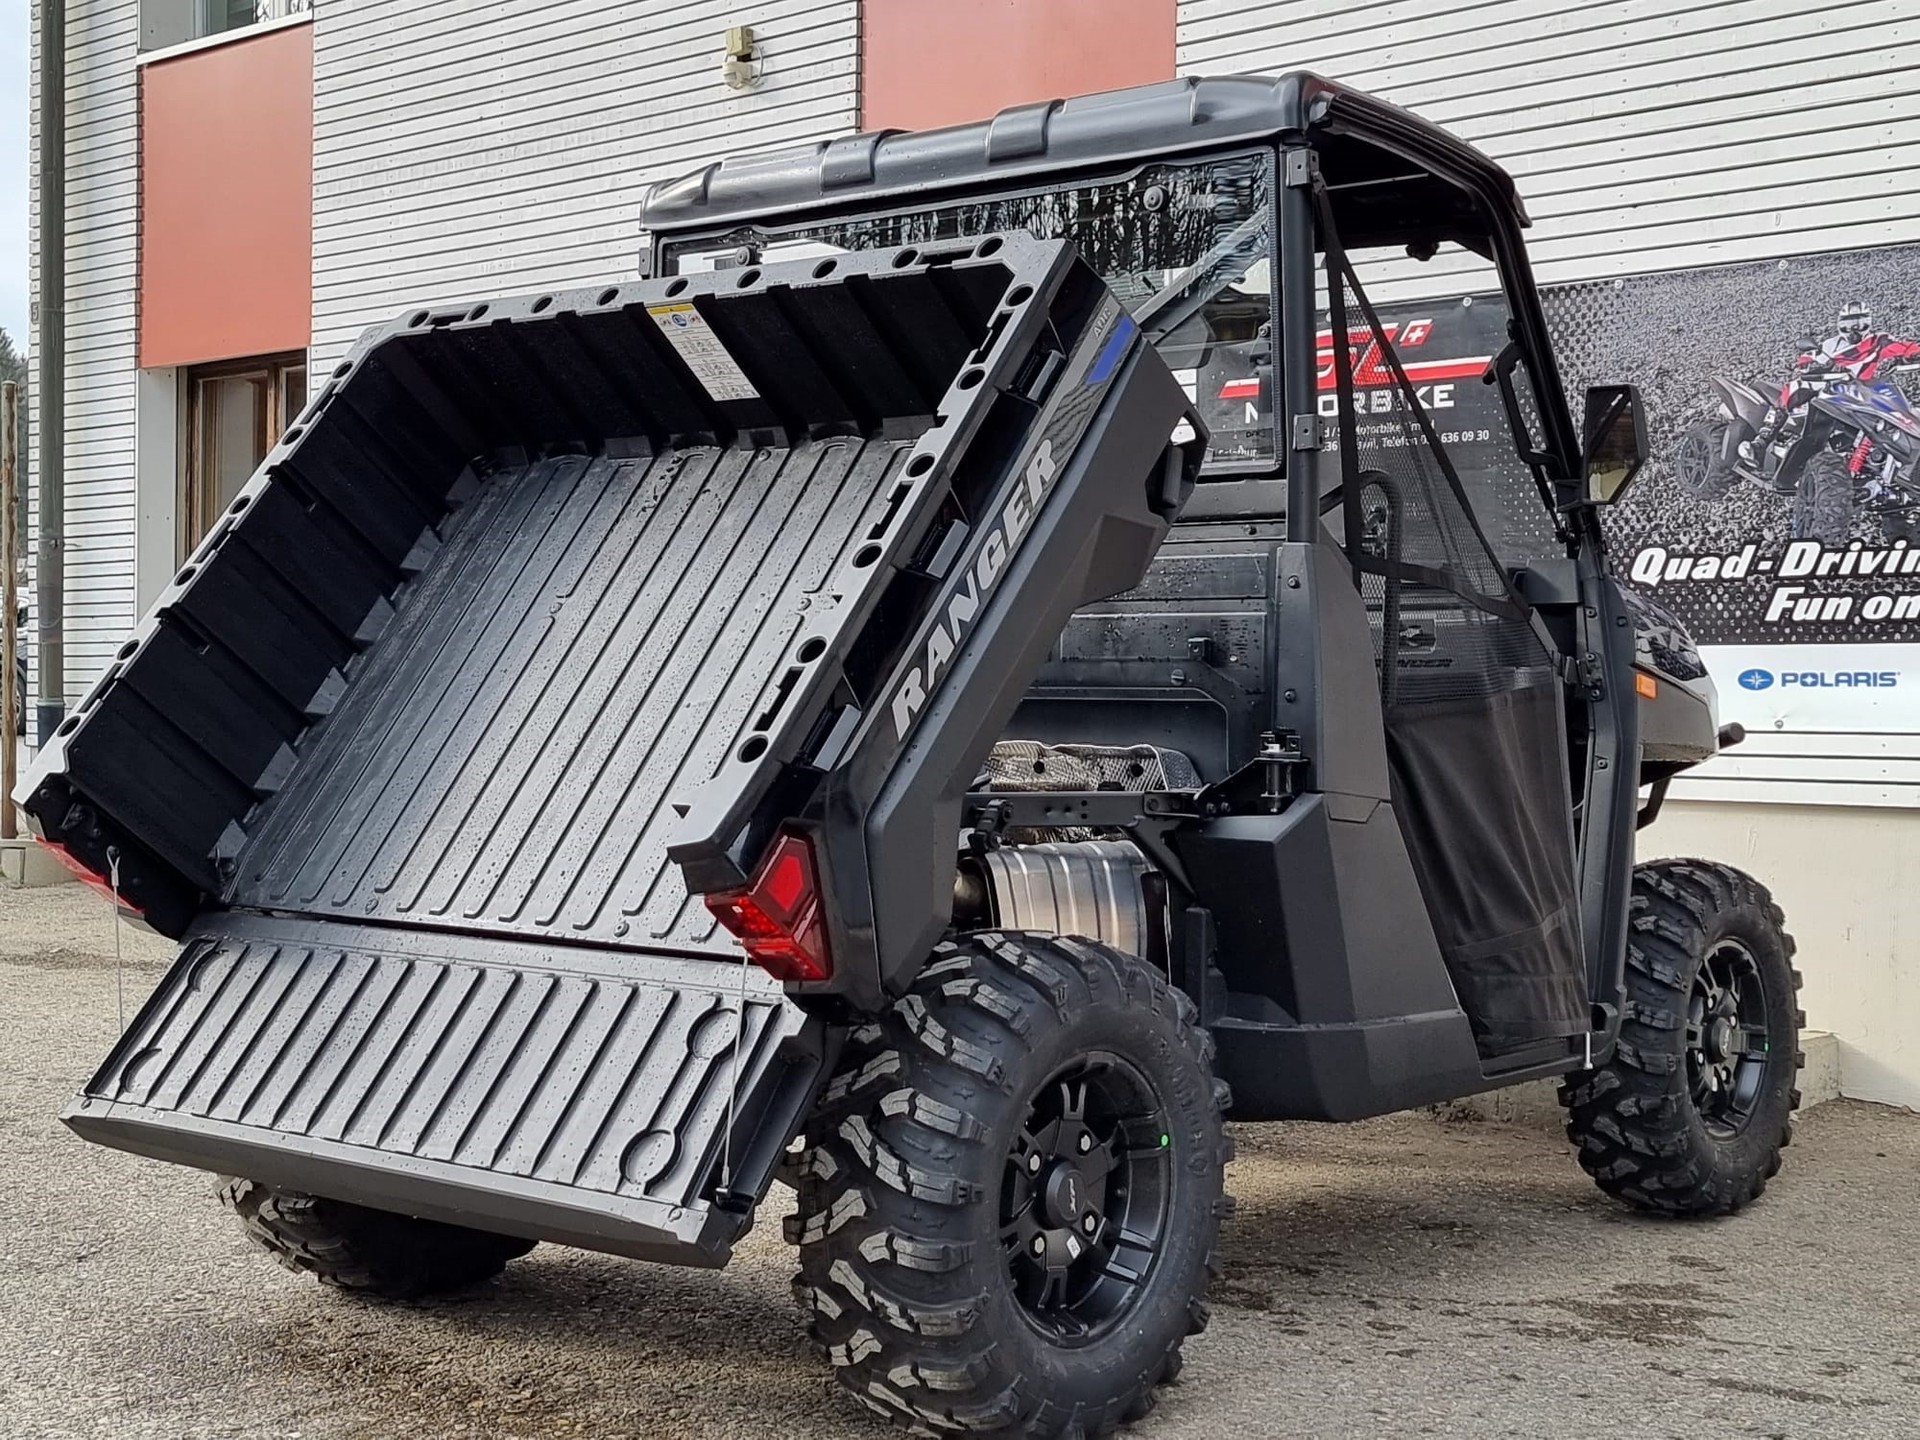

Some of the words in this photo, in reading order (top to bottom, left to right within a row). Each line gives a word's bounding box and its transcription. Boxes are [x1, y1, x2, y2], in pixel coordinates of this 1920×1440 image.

[1441, 431, 1459, 443] 636
[1461, 430, 1474, 441] 09
[1476, 429, 1490, 440] 30
[891, 438, 1057, 741] RANGER
[1764, 586, 1852, 622] Fun
[1781, 671, 1897, 688] POLARIS
